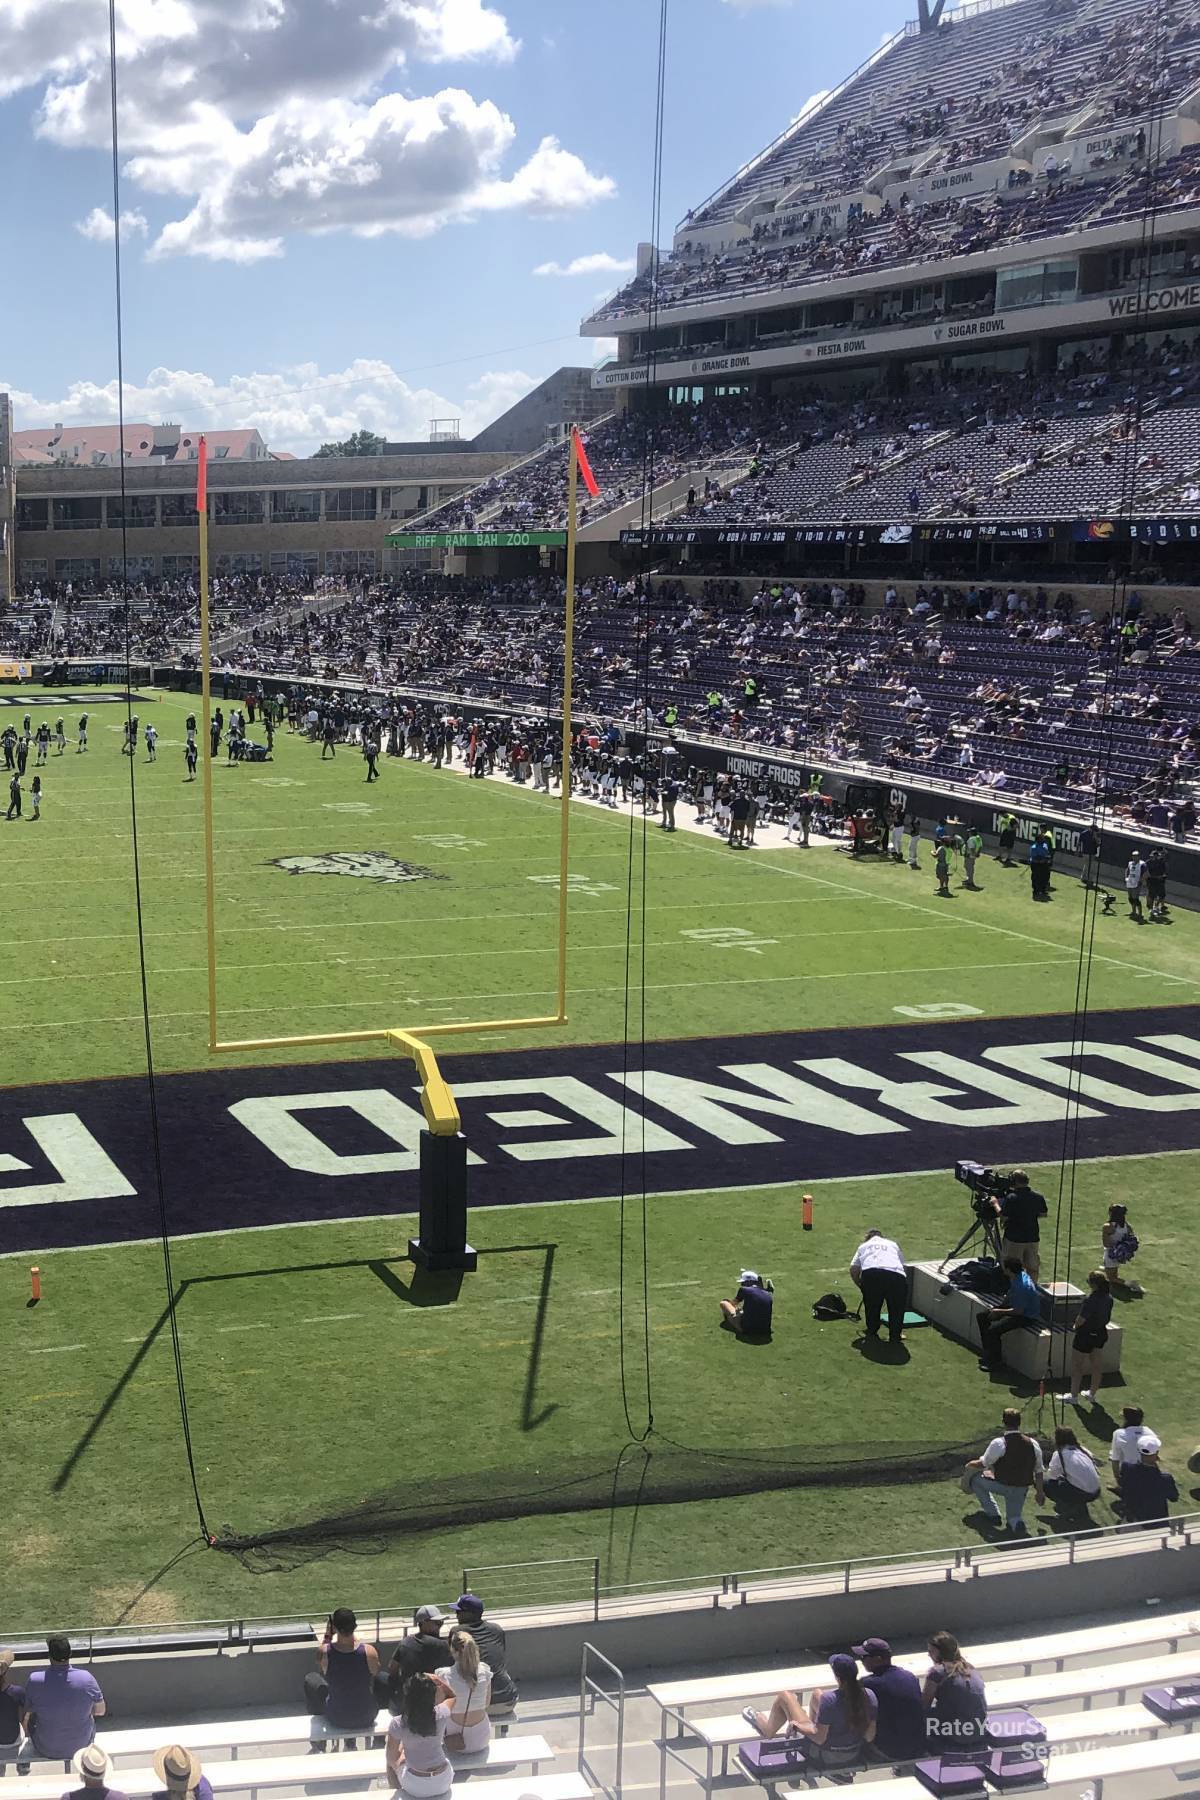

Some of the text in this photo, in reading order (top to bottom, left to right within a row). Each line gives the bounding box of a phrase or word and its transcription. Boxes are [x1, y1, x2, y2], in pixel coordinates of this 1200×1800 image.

[1086, 137, 1113, 154] DELTA
[931, 172, 974, 191] SUN BOWL
[820, 203, 842, 217] BOWL
[1109, 286, 1200, 316] WELCOME
[948, 319, 1005, 338] SUGAR BOWL
[817, 340, 866, 356] FIESTA BOWL
[702, 356, 750, 372] ORANGE BOWL
[605, 370, 649, 383] COTTON BOWL
[749, 532, 761, 541] 157
[772, 532, 786, 541] 366
[963, 529, 973, 539] 10
[979, 526, 997, 535] 14:26
[1017, 528, 1028, 538] 40
[1049, 527, 1054, 537] 0
[1130, 525, 1137, 537] 2
[1159, 525, 1167, 537] 0
[1190, 525, 1197, 537] 0
[415, 534, 530, 547] RIFF RAM BAH ZOO
[769, 765, 801, 787] FROGS
[890, 788, 907, 811] CU
[227, 1034, 1200, 1176] ORNED
[867, 1244, 888, 1252] TCU
